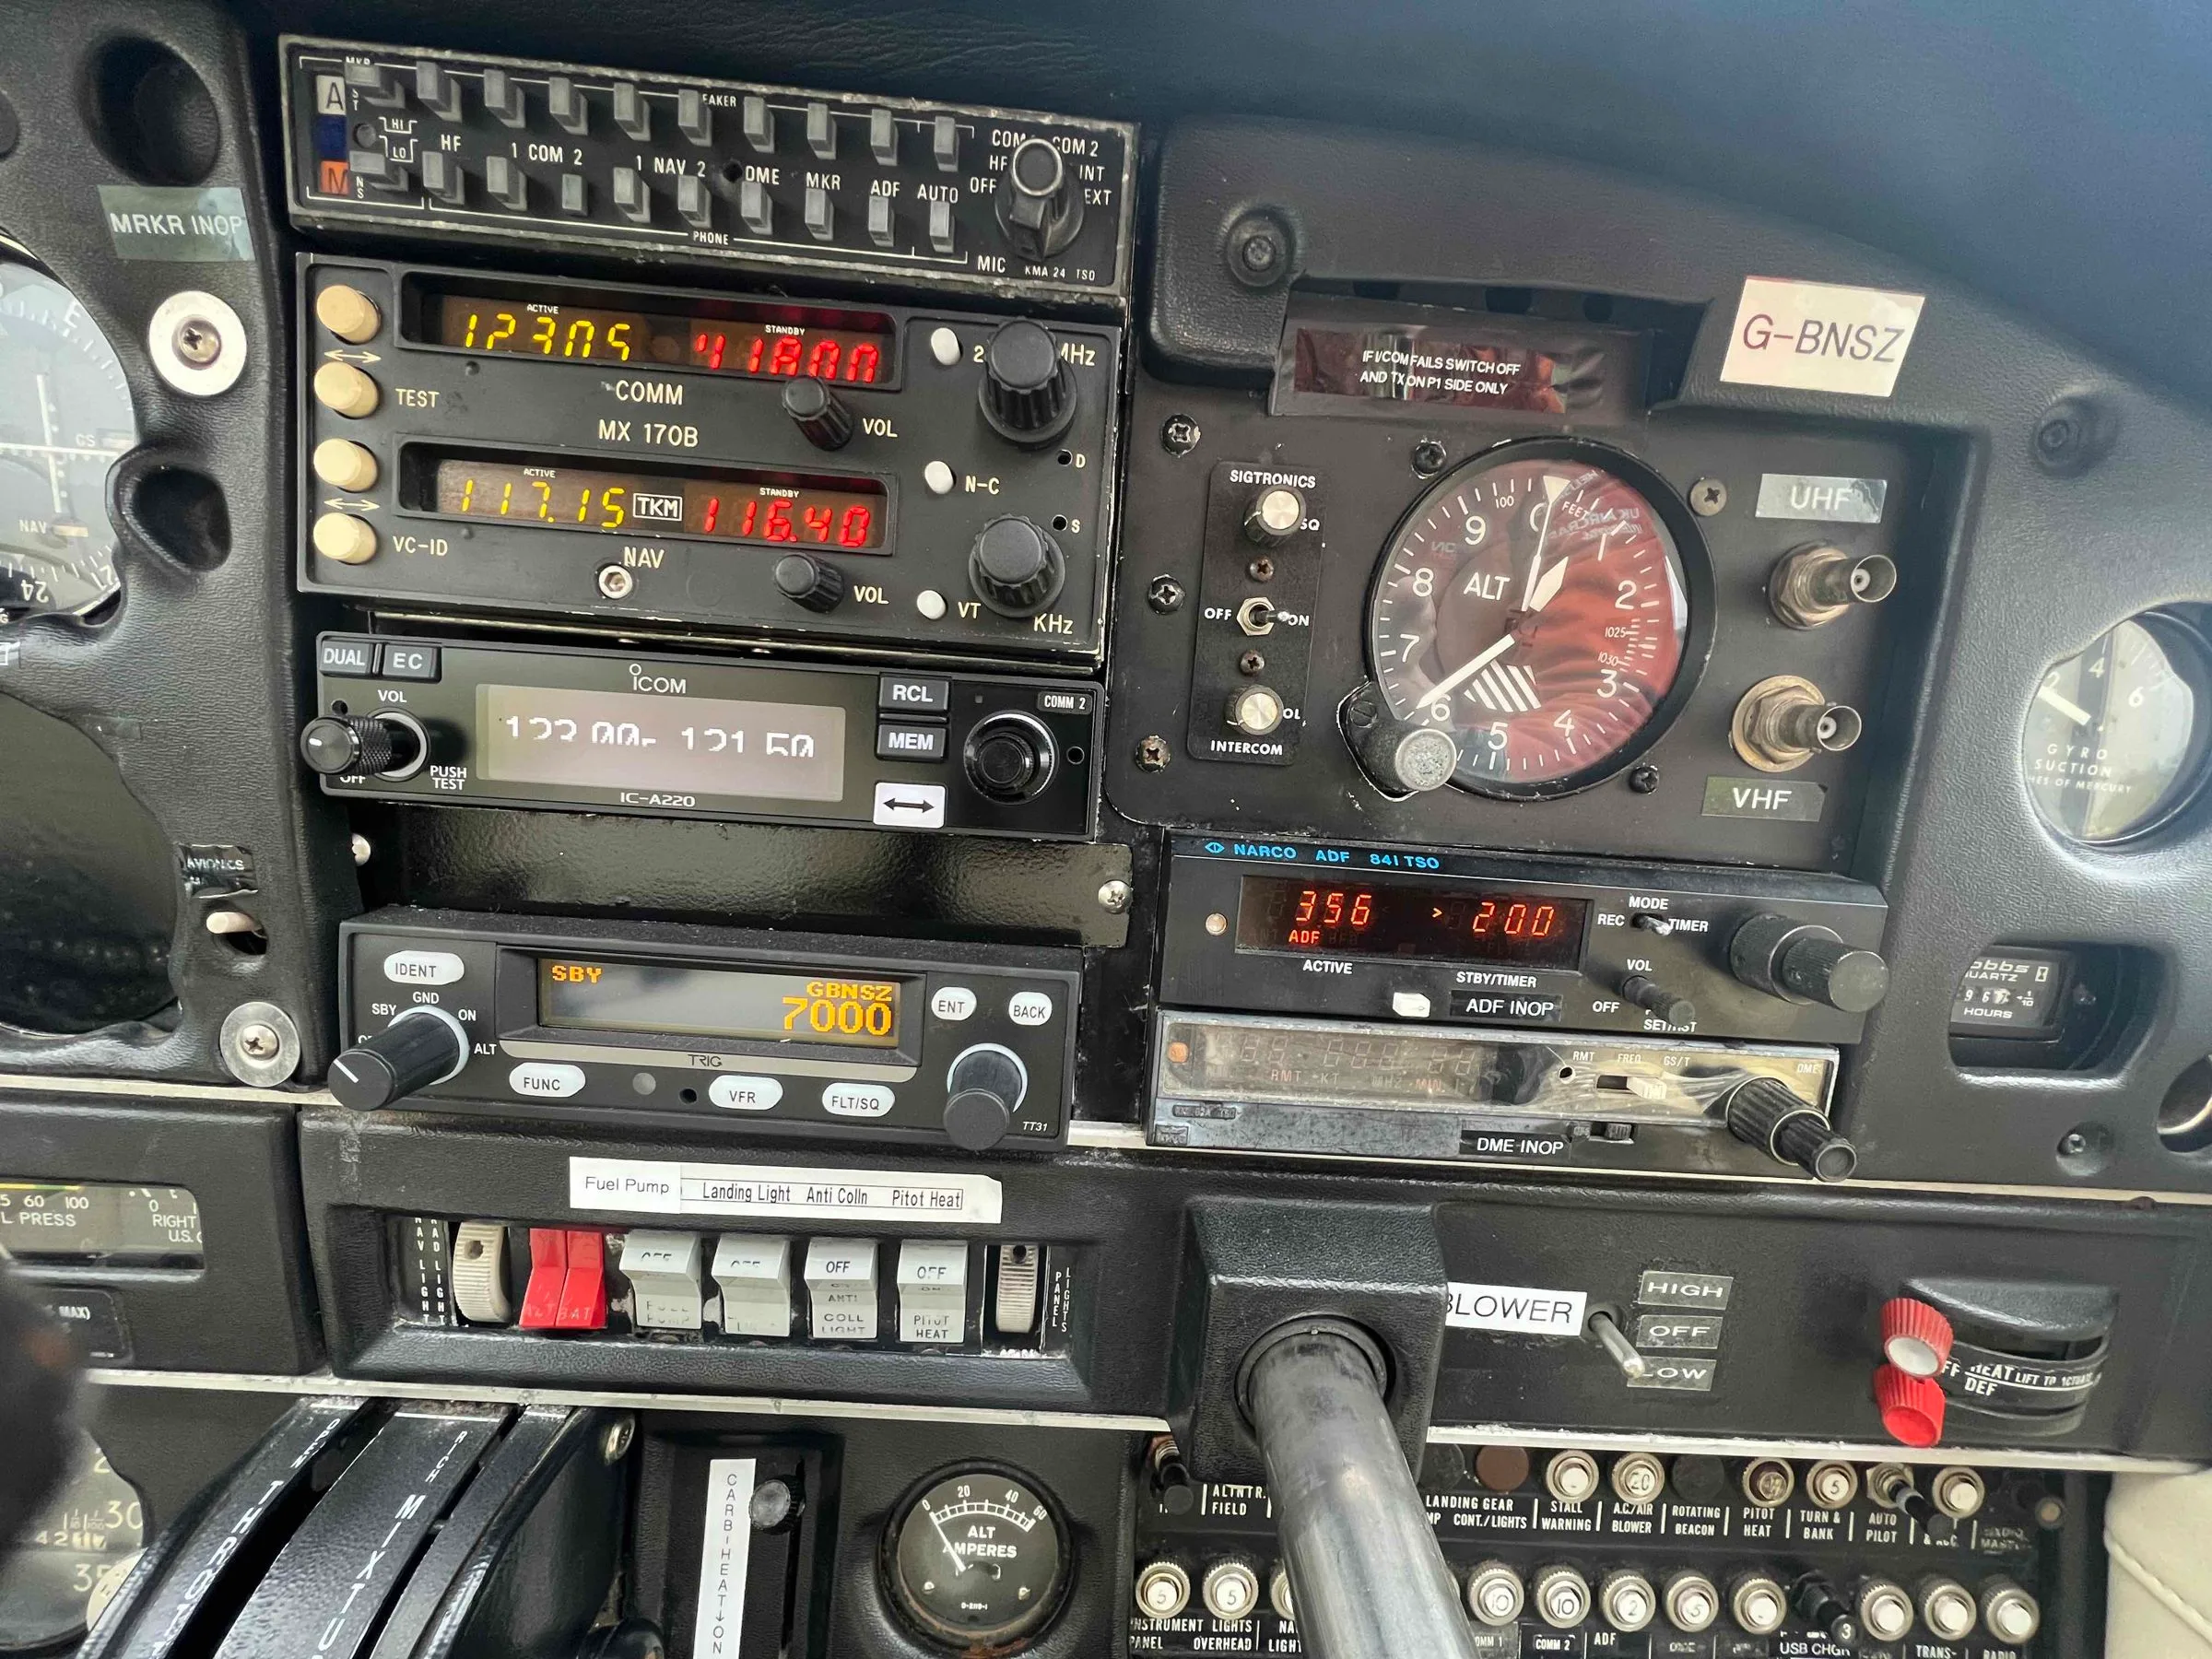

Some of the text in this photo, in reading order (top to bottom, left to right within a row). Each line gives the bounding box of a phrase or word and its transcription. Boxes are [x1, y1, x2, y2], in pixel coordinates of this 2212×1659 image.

[441, 134, 462, 152] HF
[529, 144, 563, 163] COM
[654, 156, 687, 175] NAV
[745, 166, 780, 185] DME
[806, 171, 841, 191] MKR
[870, 180, 900, 198] ADF
[971, 177, 996, 194] OFF
[917, 184, 959, 204] AUTO
[110, 213, 243, 236] MRKR INOP
[693, 230, 729, 245] PHONE
[978, 255, 1006, 273] MIC
[1025, 265, 1065, 278] KMA 24
[1077, 269, 1095, 280] TSO
[1743, 313, 1905, 363] G-BNSZ
[1362, 349, 1521, 377] IF I/COM FAILS SWITCH OFF
[1359, 370, 1508, 396] AND TX ON P1 SIDE ONLY
[395, 388, 440, 407] TEST
[616, 380, 683, 406] COMM
[599, 419, 699, 448] MX 170B
[863, 418, 898, 438] VOL
[965, 476, 1000, 495] N-C
[1230, 469, 1316, 488] SIGTRONICS
[1790, 485, 1852, 512] UHF
[636, 496, 680, 519] TKM
[1562, 500, 1590, 519] FEET
[18, 519, 47, 535] NAV
[704, 498, 870, 548] 116.40
[1464, 516, 1487, 546] 9
[393, 535, 448, 557] VC-ID
[624, 547, 665, 570] NAV
[1412, 568, 1434, 597] 8
[1464, 572, 1510, 600] ALT
[21, 579, 50, 604] 24
[853, 585, 889, 605] VOL
[1615, 580, 1637, 610] 2
[958, 601, 982, 619] VT
[1204, 607, 1232, 620] OFF
[1033, 614, 1074, 636] KHz
[1605, 627, 1627, 638] 1025
[1400, 633, 1420, 663] 7
[323, 647, 365, 666] DUAL
[393, 652, 423, 670] EC
[1597, 653, 1618, 665] 1030
[1597, 669, 1618, 699] 3
[378, 688, 407, 703] VOL
[892, 685, 934, 703] RCL
[1043, 694, 1075, 709] COMM
[888, 733, 935, 751] MEM
[1488, 722, 1508, 751] 5
[1209, 740, 1283, 756] INTERCOM
[2047, 743, 2109, 760] GYRO
[429, 764, 467, 779] PUSH
[2034, 759, 2112, 778] SUCTION
[431, 777, 465, 791] TEST
[2076, 781, 2132, 794] MERCURY
[621, 792, 696, 808] IC-A220
[1732, 787, 1792, 811] VHF
[1234, 843, 1440, 869] NARCO ADF 841 TSO
[1295, 890, 1371, 925] 356
[1629, 896, 1669, 911] MODE
[1473, 901, 1555, 937] 200
[1597, 913, 1625, 926] REC
[1668, 917, 1708, 933] TIMER
[1288, 929, 1321, 944] ADF
[395, 962, 437, 978] IDENT
[1303, 959, 1353, 975] ACTIVE
[1627, 959, 1653, 972] VOL
[552, 965, 602, 983] SBY
[1456, 971, 1537, 988] STBY/TIMER
[412, 991, 440, 1005] GND
[806, 981, 892, 1003] GBNSZ
[371, 1003, 396, 1016] SBY
[937, 1000, 966, 1014] ENT
[1013, 1005, 1046, 1019] BACK
[1465, 998, 1554, 1016] ADF INOP
[1592, 1000, 1620, 1013] OFF
[1963, 1006, 2014, 1019] HOURS
[458, 1009, 477, 1021] ON
[782, 996, 892, 1036] 7000
[474, 1042, 497, 1055] ALT
[1572, 1051, 1595, 1062] RMT
[688, 1054, 723, 1067] TRIG
[523, 1077, 561, 1091] FUNC
[729, 1090, 757, 1104] VFR
[831, 1096, 880, 1112] FLT/SQ
[1477, 1137, 1564, 1156] DME INOP
[585, 1175, 960, 1209] Fuel Pump Landing Light Anti Colln Pitot Heat
[19, 1212, 76, 1228] PRESS
[152, 1215, 197, 1229] RIGHT
[169, 1230, 194, 1243] U.S.
[826, 1261, 851, 1274] OFF
[1647, 1282, 1724, 1298] HIGH
[1051, 1271, 1062, 1327] PANEL
[1445, 1293, 1572, 1324] BLOWER
[824, 1313, 863, 1324] COLL
[1649, 1324, 1711, 1337] OFF
[1964, 1376, 1998, 1396] DEF
[2016, 1371, 2041, 1386] LIFT
[289, 1418, 341, 1469] OPEN
[424, 1430, 468, 1483] RICH
[1211, 1501, 1247, 1516] FIELD
[1426, 1494, 1514, 1512] LANDING GEAR
[1549, 1500, 1583, 1514] STALL
[1672, 1505, 1721, 1520] ROTATING
[1743, 1506, 1775, 1522] PITOT
[1800, 1509, 1830, 1524] TURN
[1868, 1512, 1898, 1526] AUTO
[967, 1525, 996, 1539] ALT
[1541, 1517, 1592, 1532] WARNING
[1611, 1520, 1653, 1535] BLOWER
[1675, 1523, 1715, 1536] BEACON
[1743, 1524, 1772, 1538] HEAT
[1804, 1526, 1834, 1540] BANK
[1866, 1529, 1898, 1544] PILOT
[1130, 1617, 1253, 1633] INSTRUMENT LIGHTS
[1129, 1635, 1164, 1650] PANEL
[1193, 1636, 1253, 1651] OVERHEAD
[1780, 1641, 1808, 1655] USB
